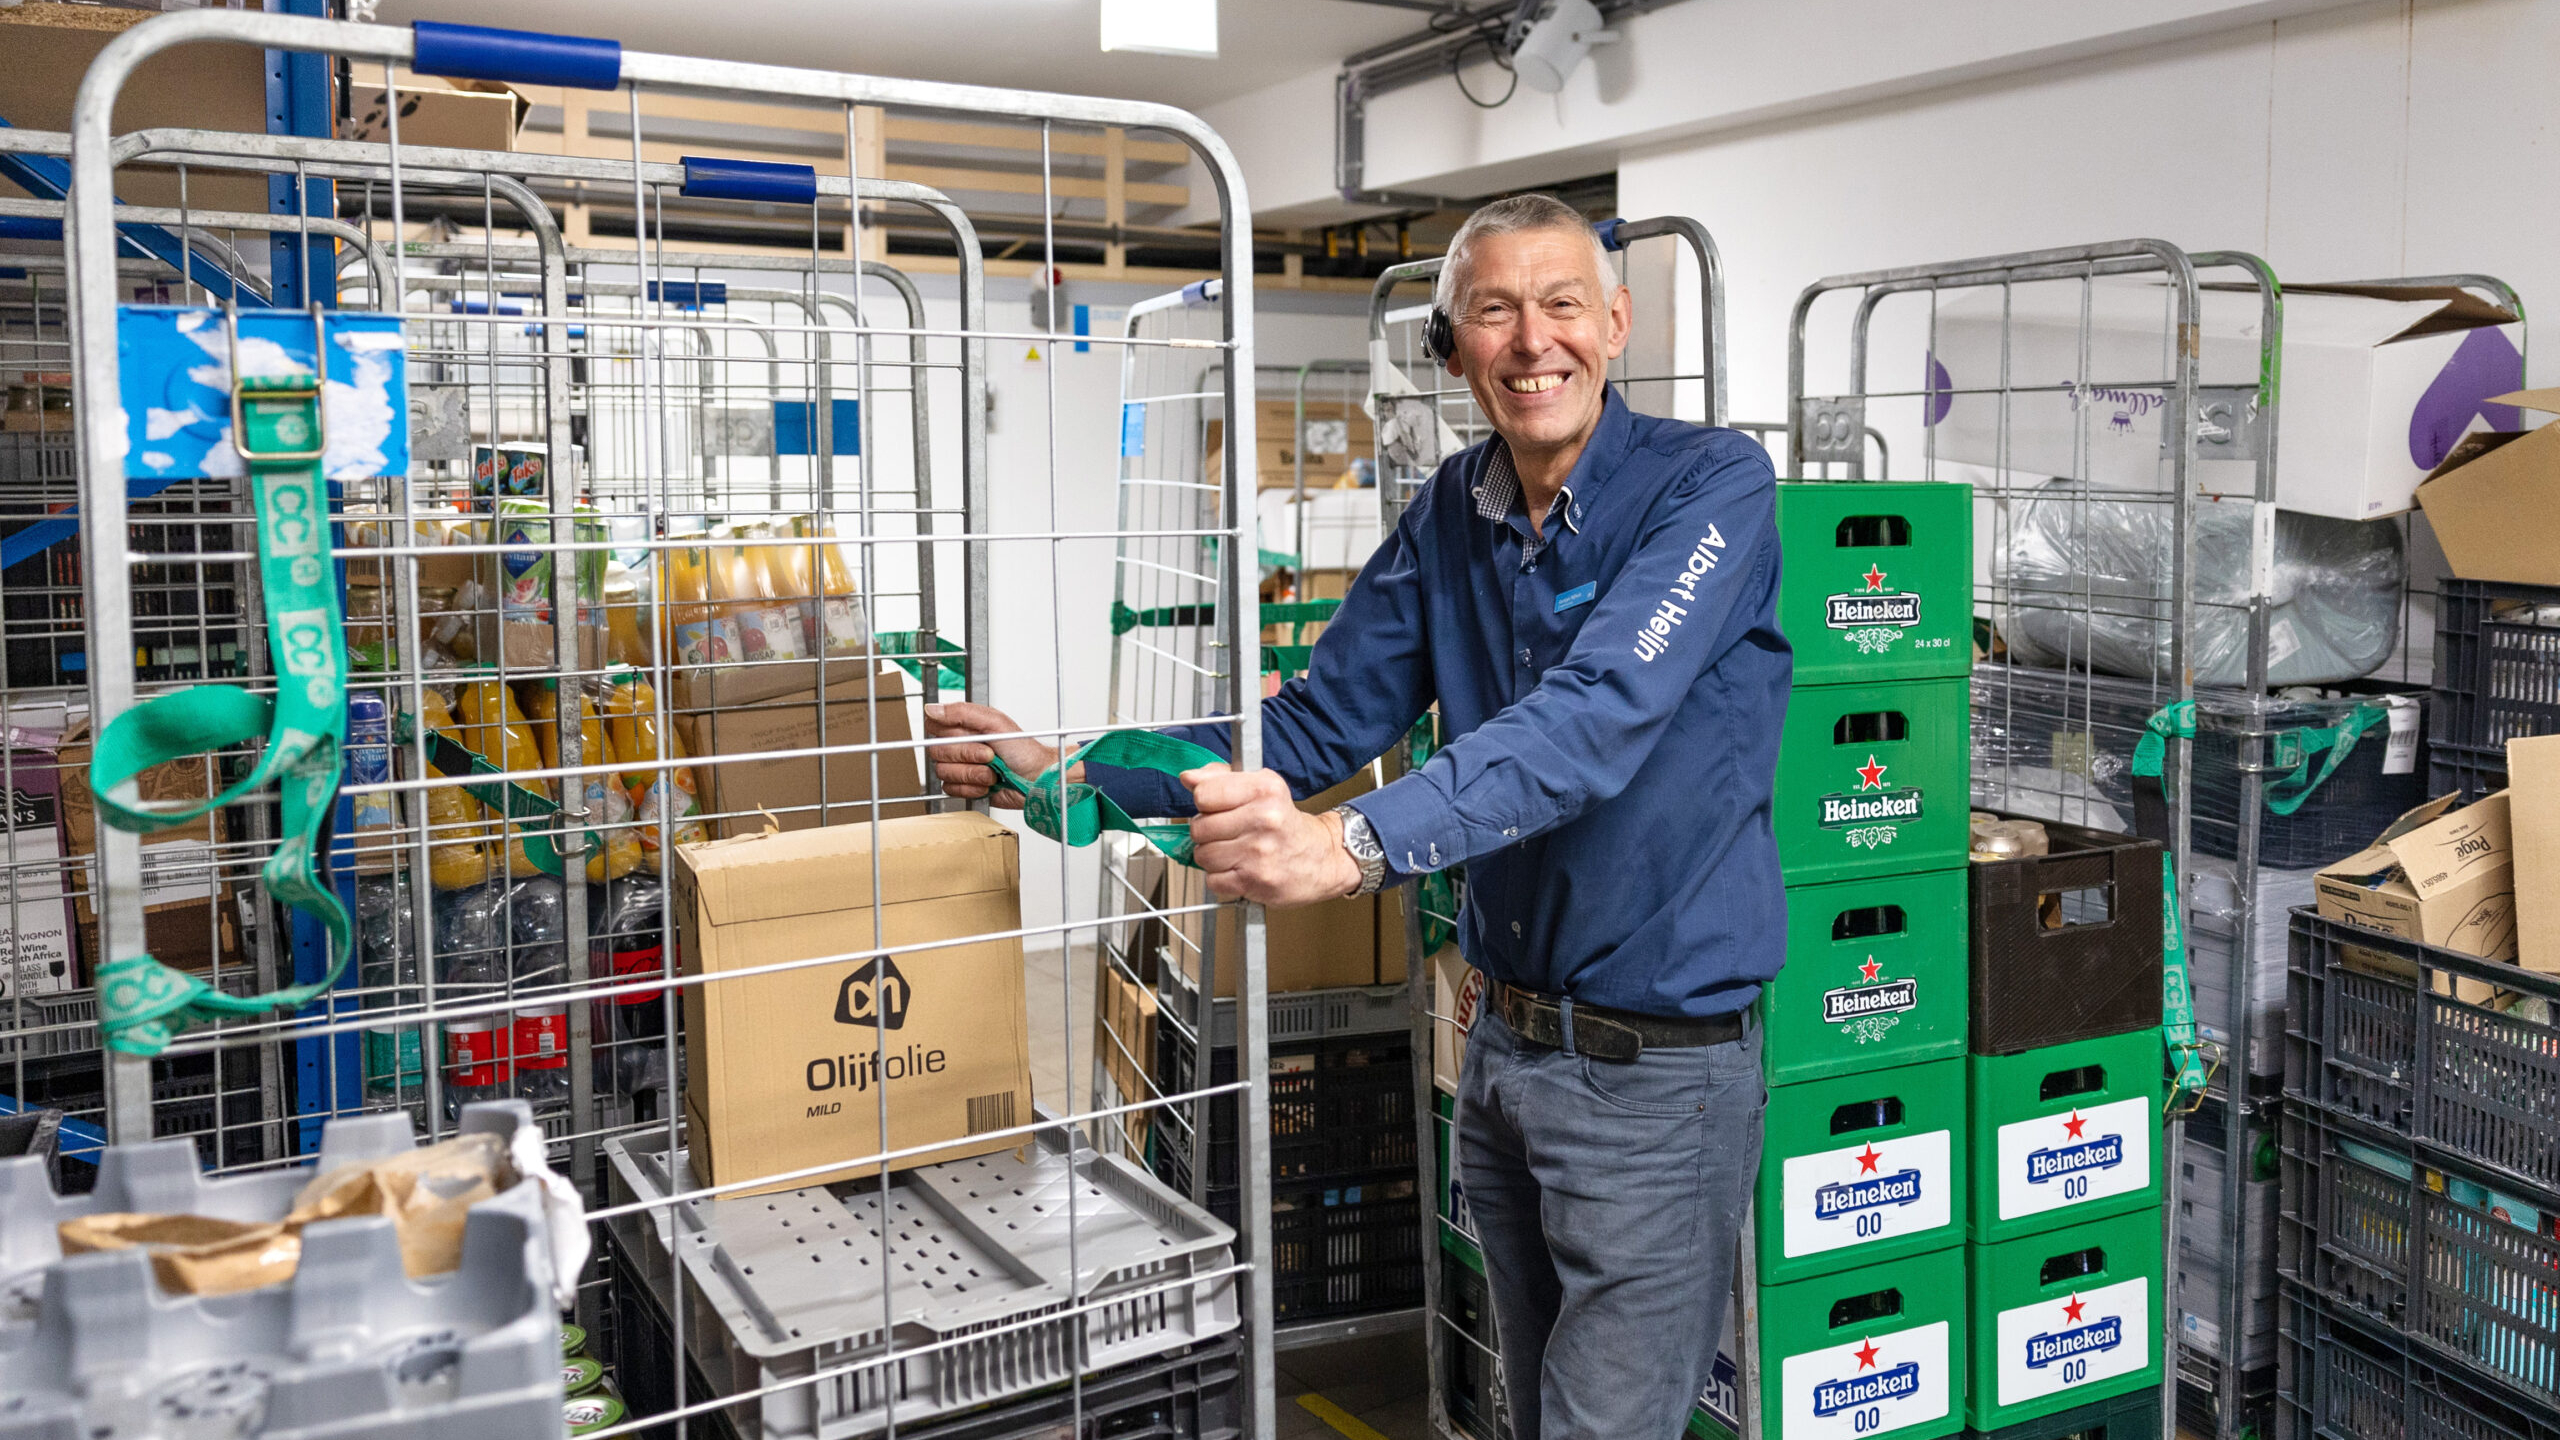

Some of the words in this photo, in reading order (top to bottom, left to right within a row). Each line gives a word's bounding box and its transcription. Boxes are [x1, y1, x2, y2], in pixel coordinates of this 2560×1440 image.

[1833, 601, 1914, 621] Heineken
[1633, 600, 1688, 662] Heijn
[1915, 639, 1925, 648] 24
[1932, 638, 1942, 648] 30
[1943, 638, 1951, 647] cl
[1824, 795, 1918, 822] Heineken
[2454, 835, 2492, 857] Page
[0, 929, 62, 945] SAVIGNON
[21, 944, 48, 953] Wine
[1, 955, 31, 966] Soth
[33, 951, 62, 961] Africa
[1830, 989, 1910, 1015] Heineken
[806, 1043, 946, 1092] Olijfolie
[806, 1102, 842, 1119] MILD
[2032, 1145, 2118, 1178] Heineken
[1821, 1180, 1916, 1213] Heineken
[2064, 1175, 2088, 1200] 0.0
[1856, 1212, 1882, 1237] 0.0
[2031, 1326, 2117, 1362] Heineken
[2063, 1358, 2086, 1384] 0.0
[1819, 1372, 1914, 1411] Heineken
[1854, 1406, 1880, 1433] 0.0
